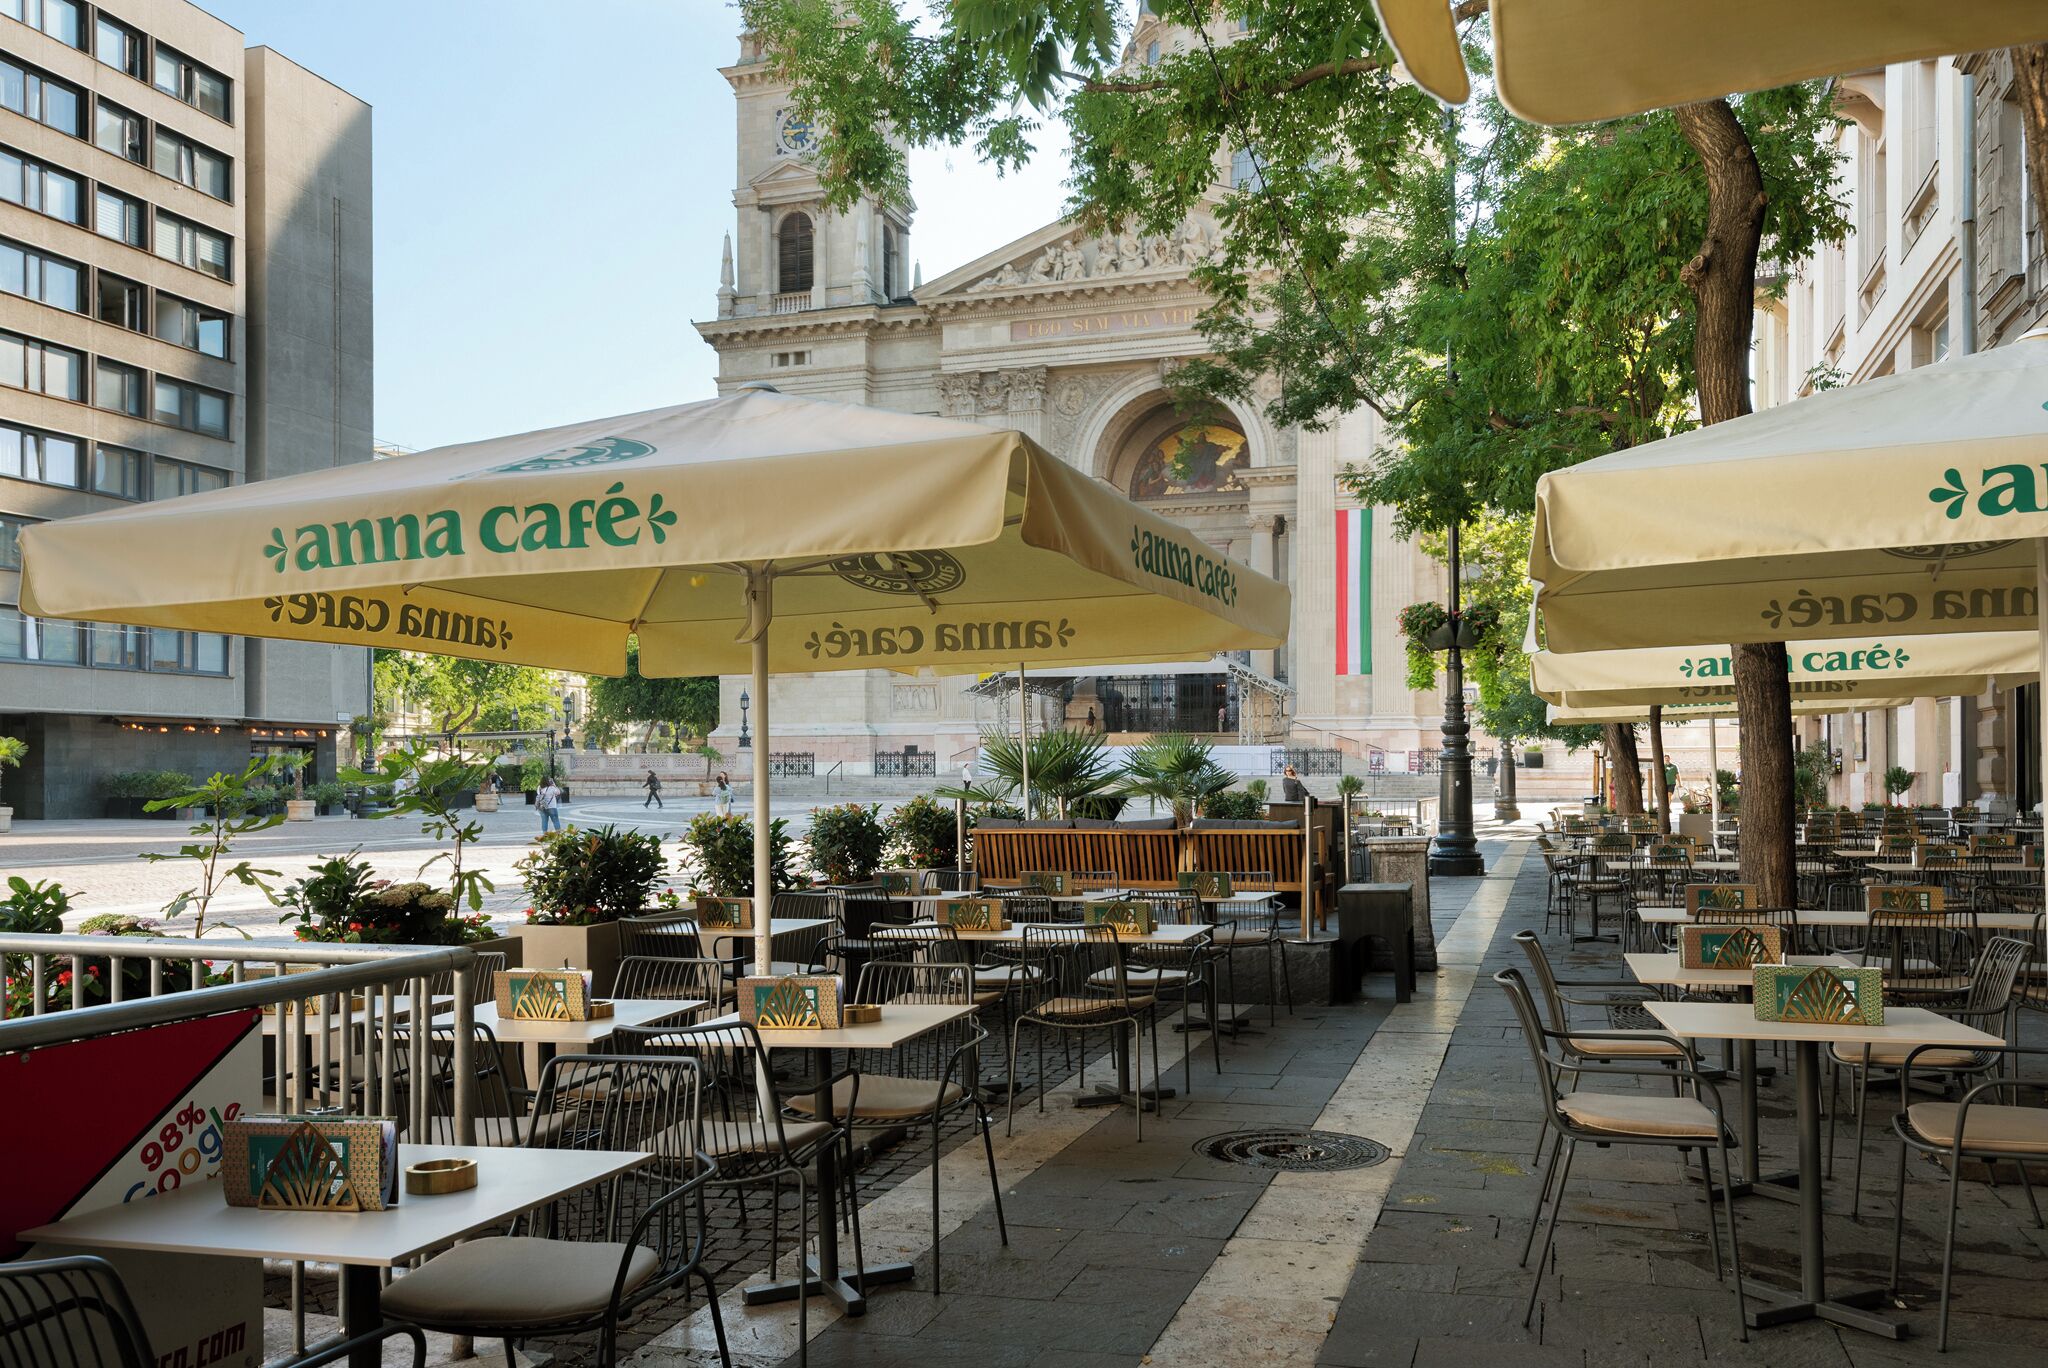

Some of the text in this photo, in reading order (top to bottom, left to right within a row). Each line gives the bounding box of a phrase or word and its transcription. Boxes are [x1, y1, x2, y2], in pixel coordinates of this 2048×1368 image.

[1028, 320, 1062, 337] EGO
[1072, 316, 1109, 333] SUM
[295, 481, 641, 572] anna café
[1142, 531, 1231, 606] anna café
[1802, 643, 1892, 672] café
[140, 1100, 206, 1172] 98%
